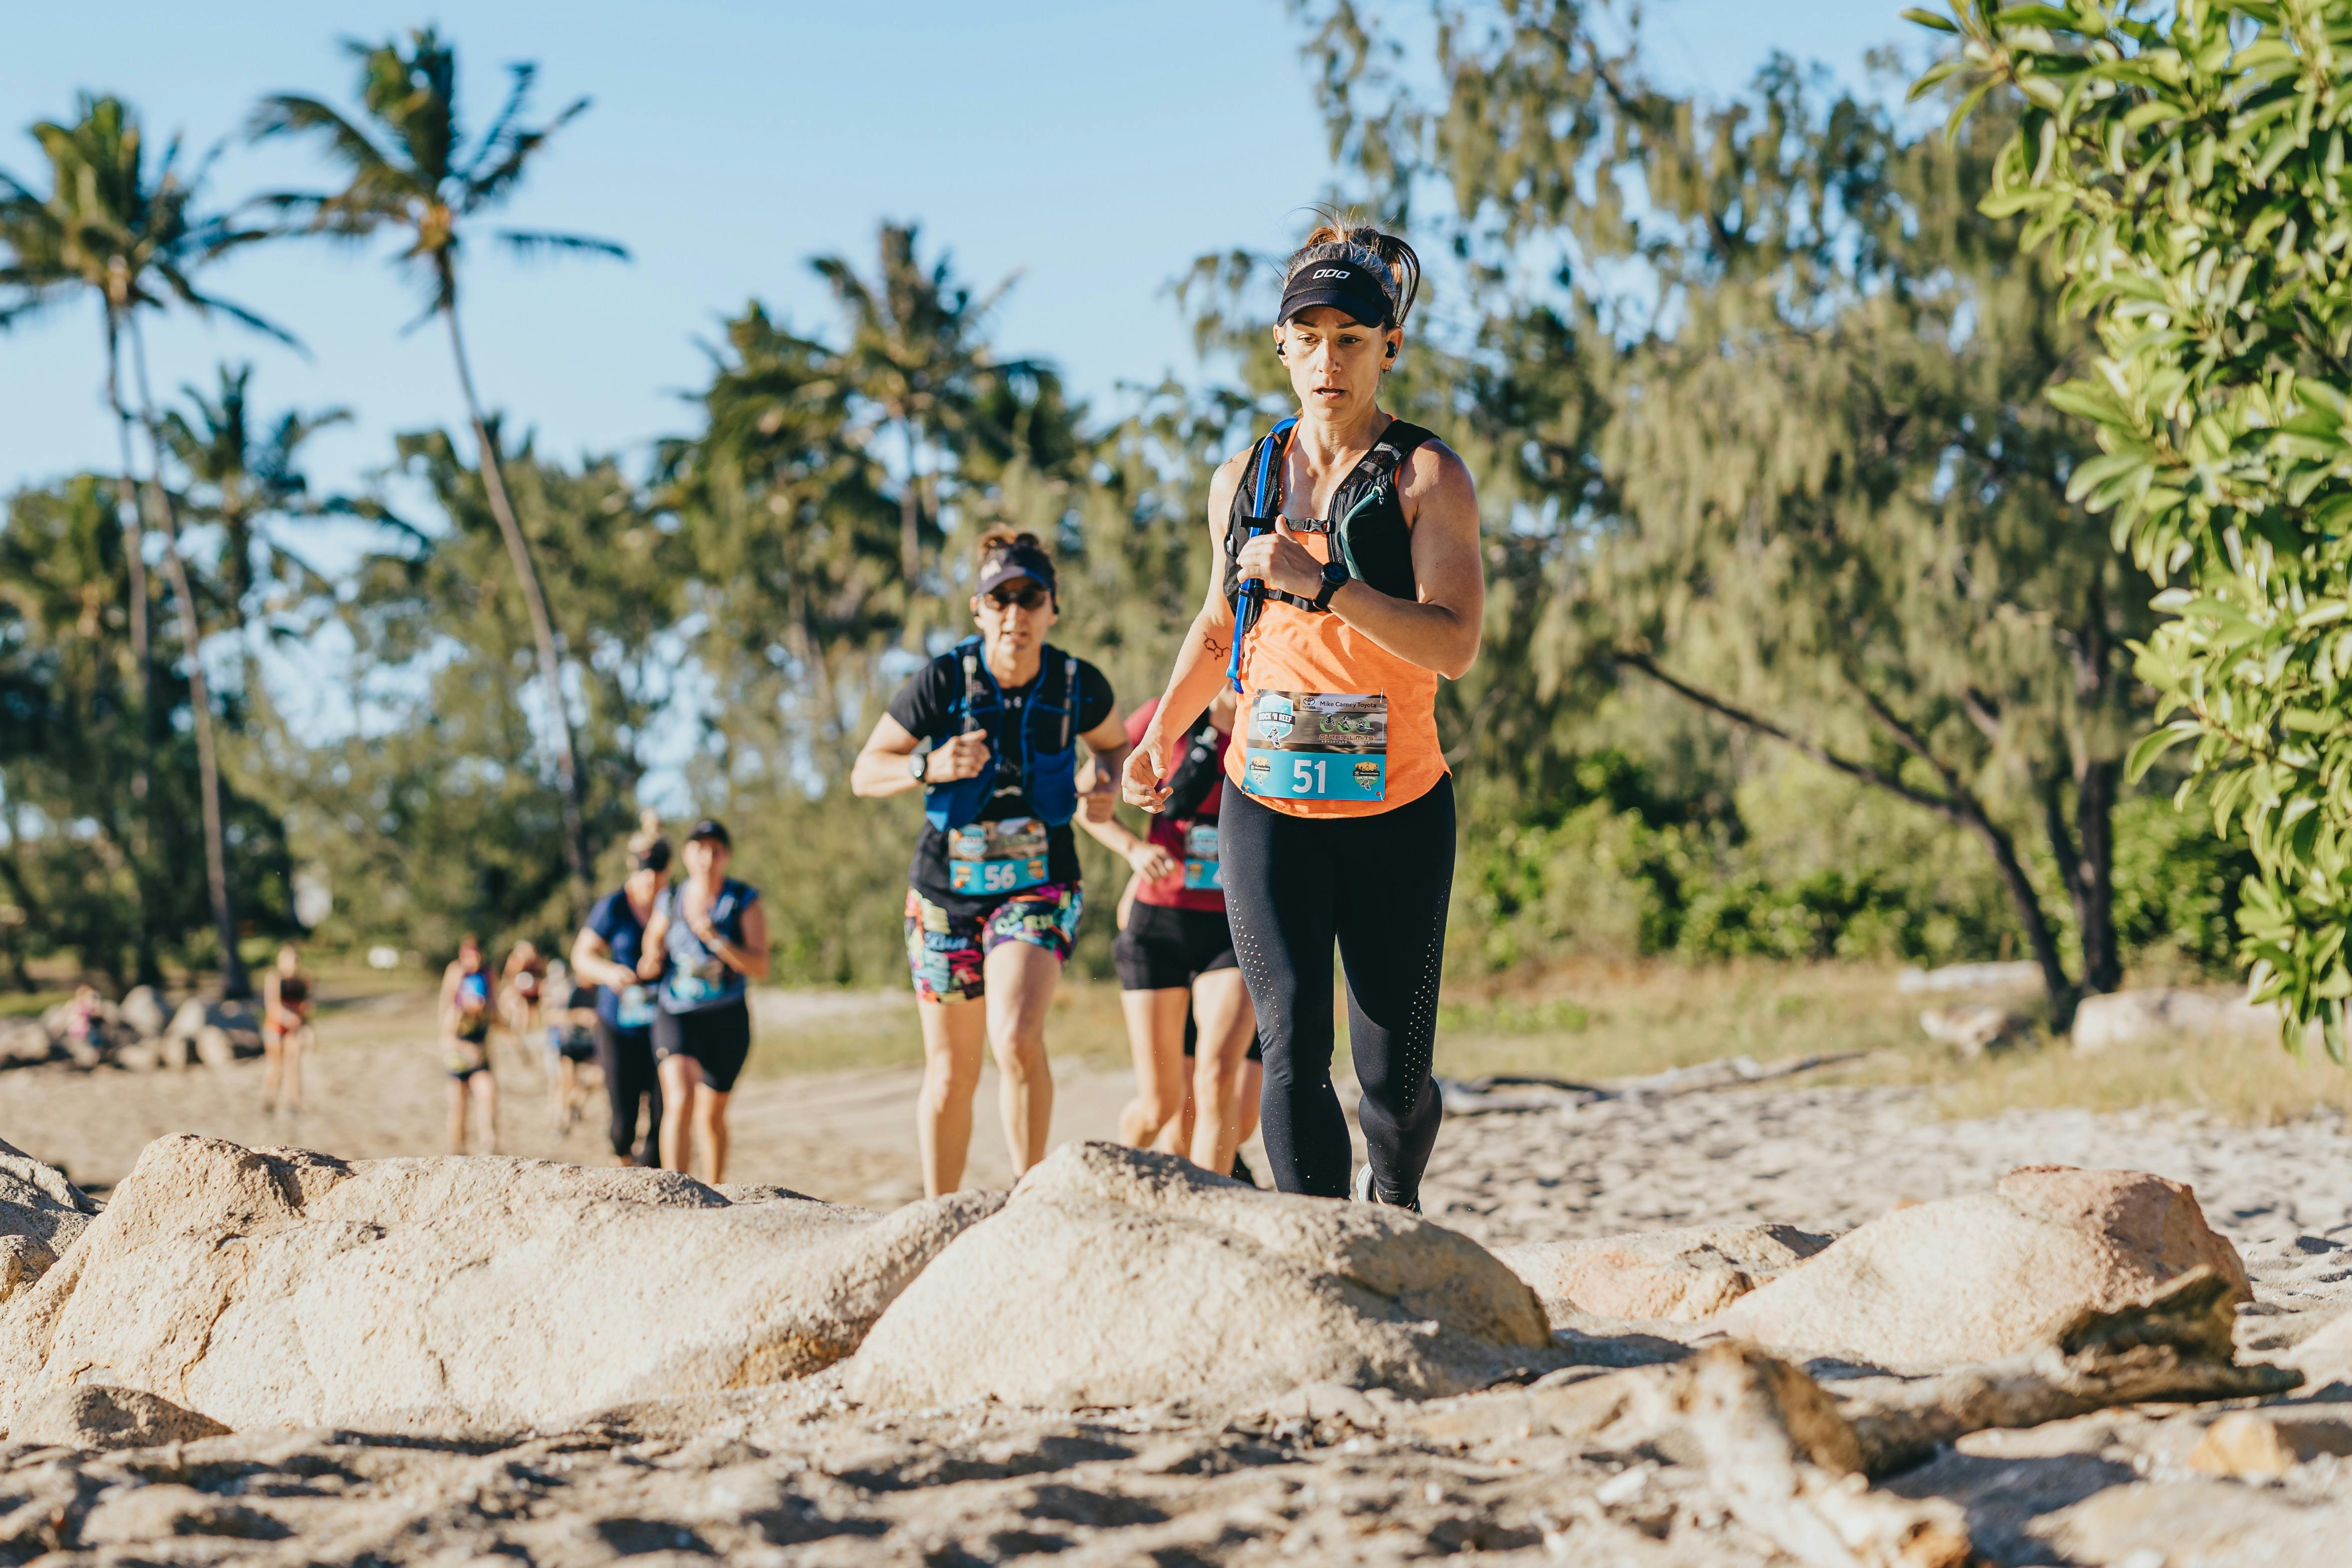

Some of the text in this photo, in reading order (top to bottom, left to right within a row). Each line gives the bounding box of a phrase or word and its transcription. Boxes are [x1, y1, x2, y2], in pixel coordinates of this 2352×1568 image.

[1259, 712, 1272, 721] ROCK
[1279, 713, 1293, 723] REEF
[1292, 759, 1326, 793] 51
[984, 863, 1017, 891] 56
